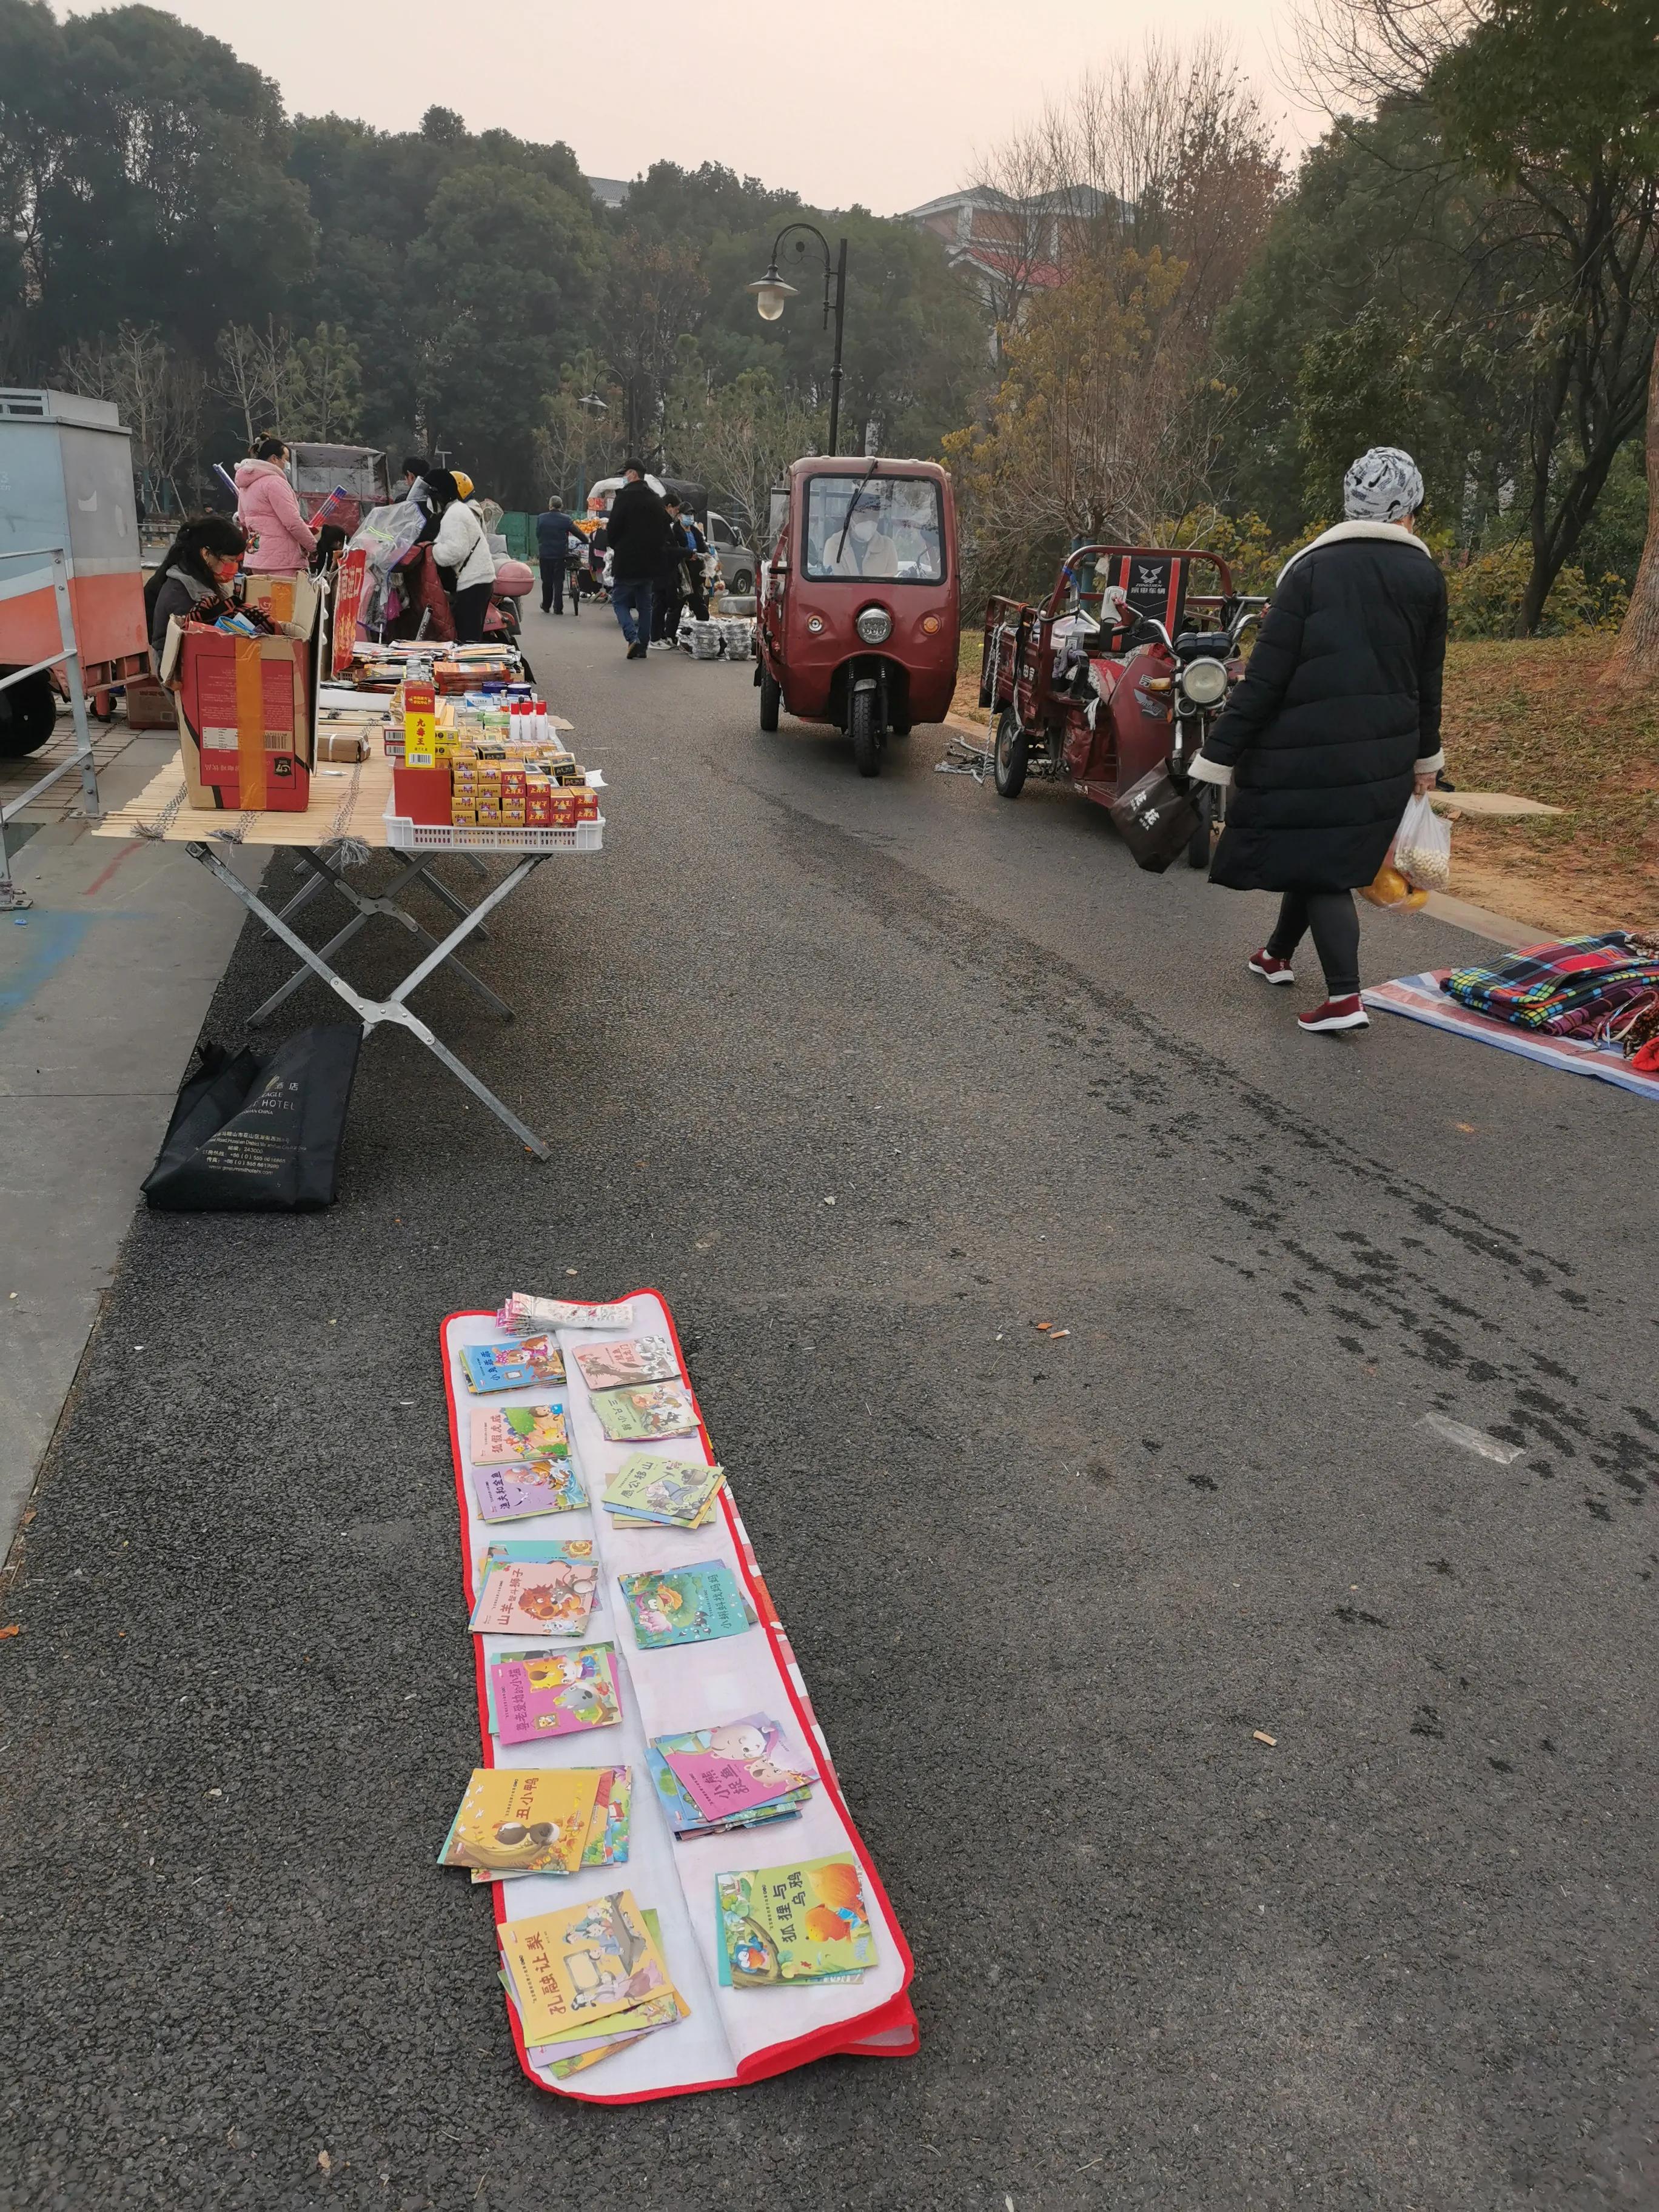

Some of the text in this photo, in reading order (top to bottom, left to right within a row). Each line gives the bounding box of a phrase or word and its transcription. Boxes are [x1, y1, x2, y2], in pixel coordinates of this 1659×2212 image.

[340, 565, 363, 601] 南进口
[262, 1099, 295, 1110] HOTEL
[484, 1350, 502, 1381] 小兔乖乖
[492, 1413, 503, 1454] 狐假虎威
[607, 1398, 634, 1432] 三只小猪
[491, 1470, 511, 1510] 渔夫和金鱼
[619, 1461, 654, 1500] 愚公移山
[497, 1567, 524, 1626] 山羊智斗狮子
[708, 1574, 732, 1629] 小蝌蚪找妈妈
[509, 1668, 529, 1731] 尊老爱幼的小猫
[516, 1777, 540, 1820] 丑小鸭
[701, 1769, 729, 1800] 小熊
[720, 1763, 750, 1795] 捉鱼
[786, 1871, 806, 1907] 乌鸦
[773, 1883, 797, 1943] 狐狸与
[525, 1931, 567, 2016] 孔融让梨
